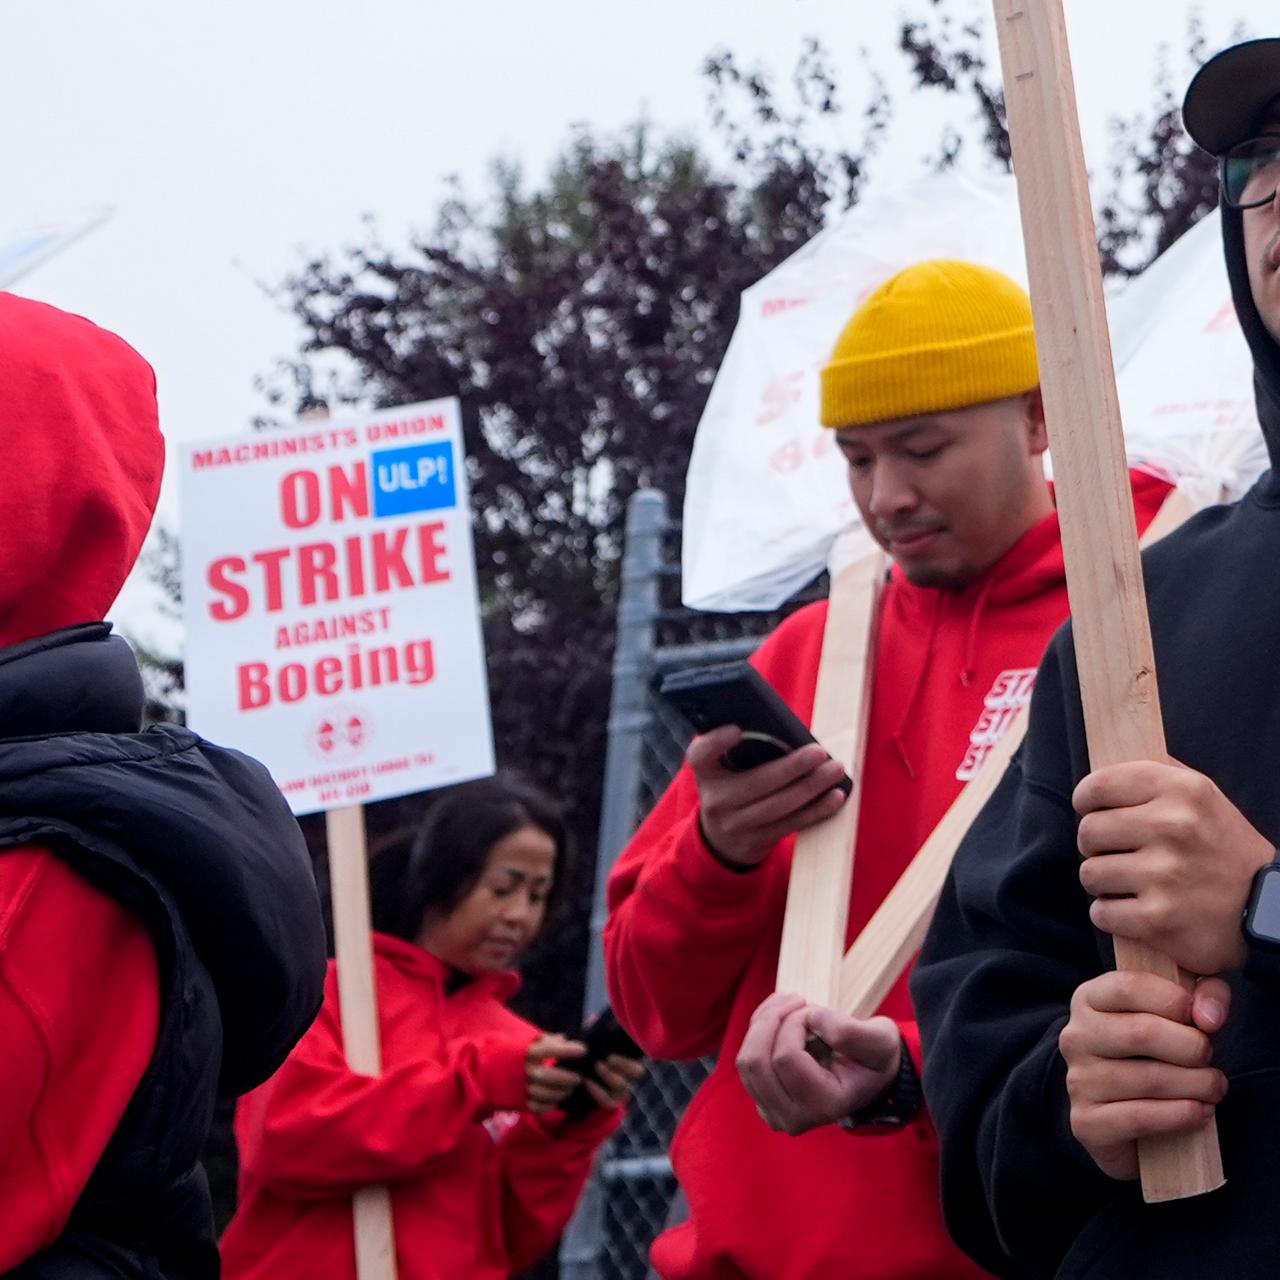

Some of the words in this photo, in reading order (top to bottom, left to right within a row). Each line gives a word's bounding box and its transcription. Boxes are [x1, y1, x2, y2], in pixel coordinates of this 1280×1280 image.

[192, 428, 358, 470] MACHINISTS
[367, 414, 446, 442] UNION
[377, 454, 449, 493] ULP!
[279, 459, 371, 532] ON
[206, 519, 453, 623] STRIKE
[275, 606, 392, 650] AGAINST
[235, 637, 437, 713] Boeing
